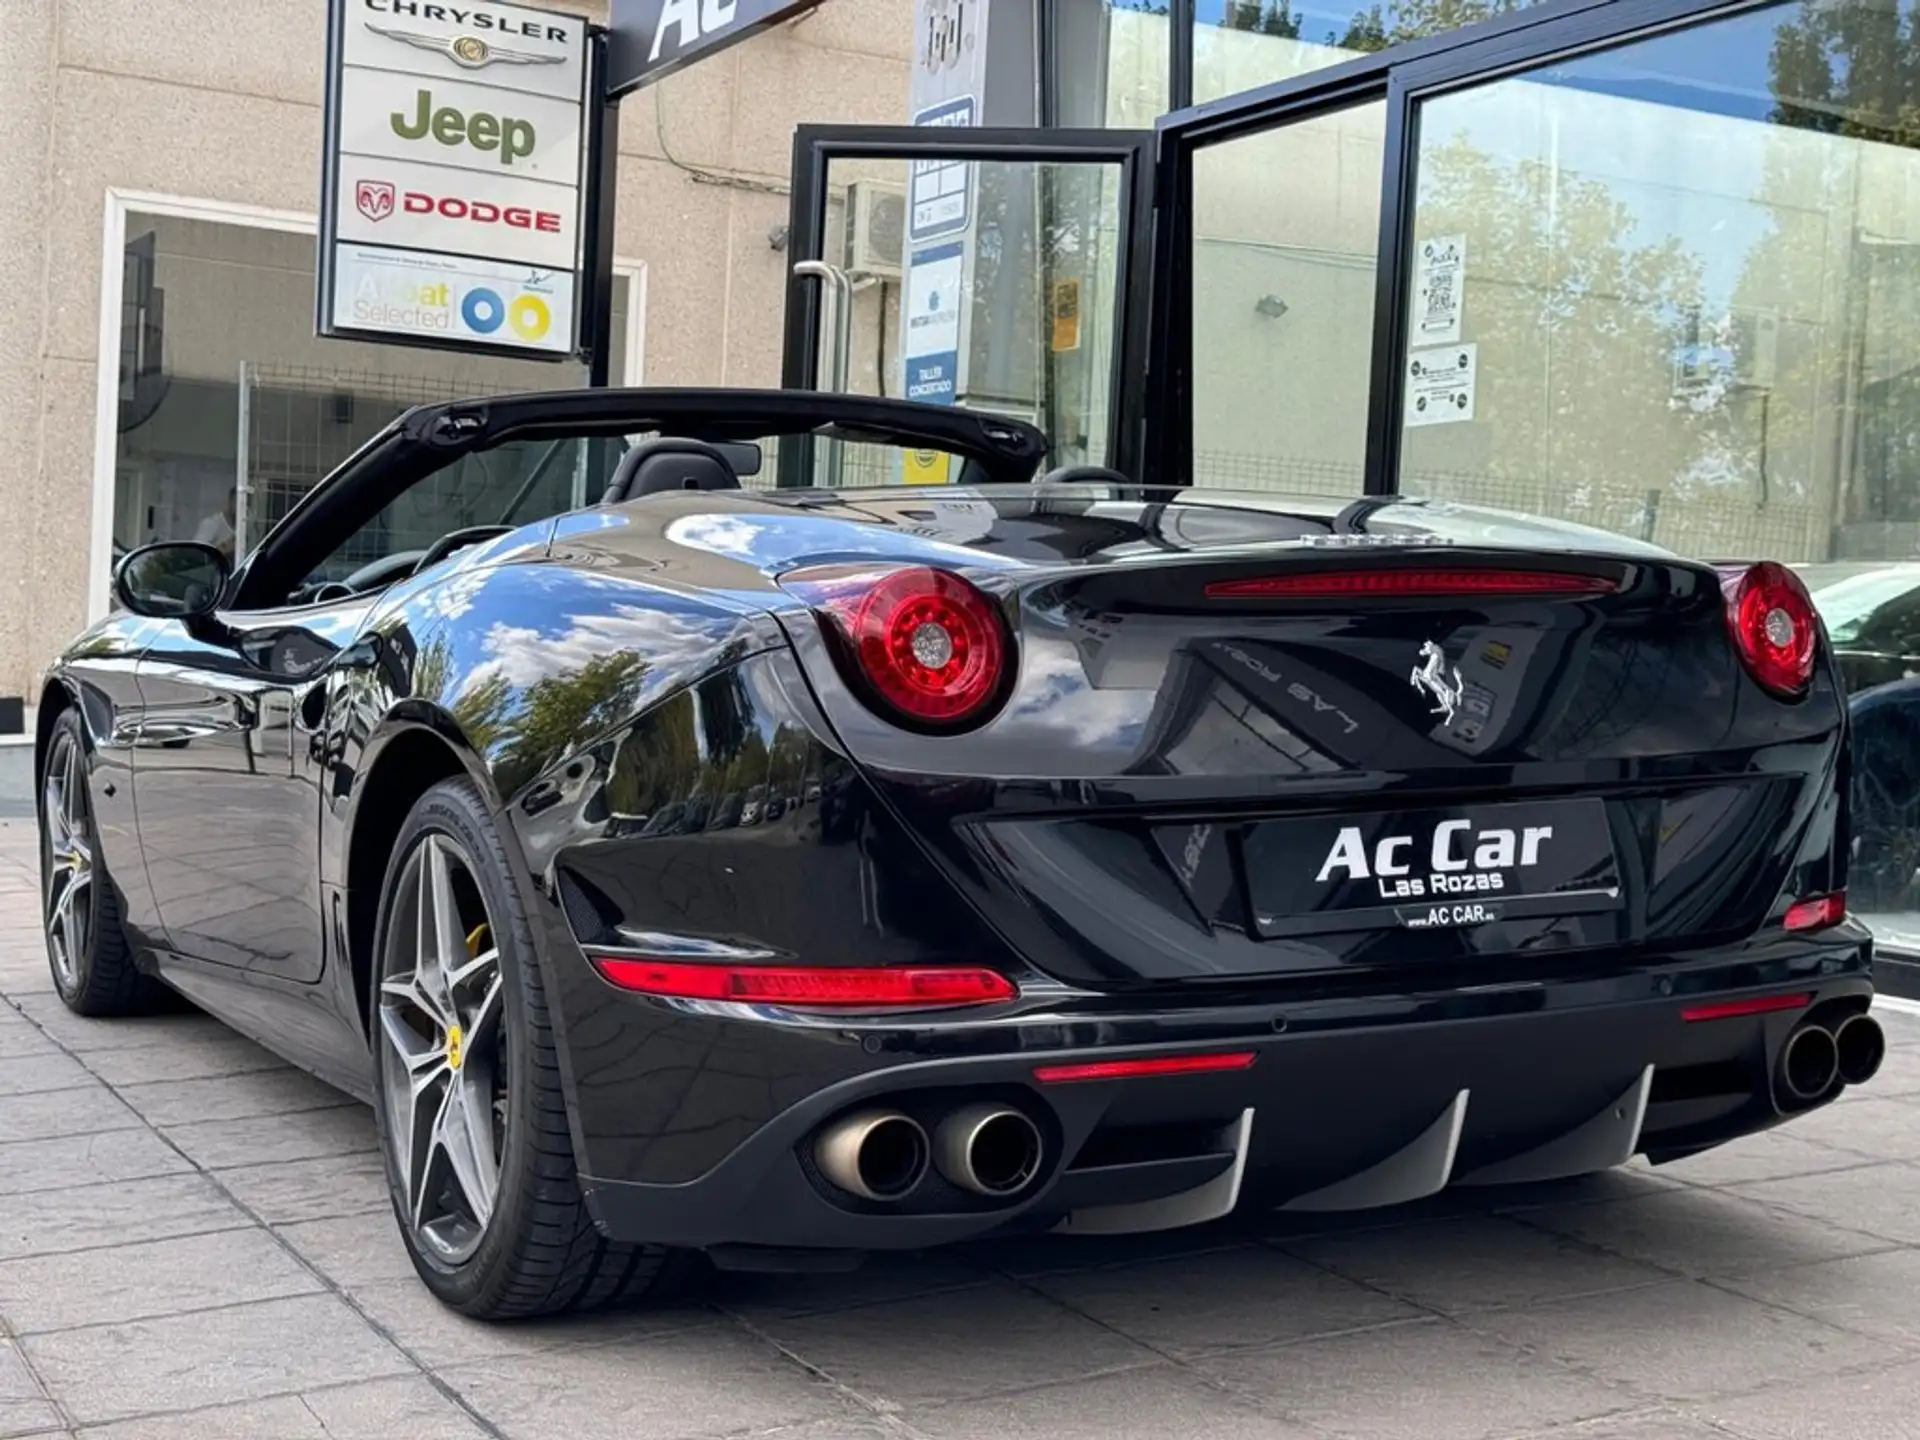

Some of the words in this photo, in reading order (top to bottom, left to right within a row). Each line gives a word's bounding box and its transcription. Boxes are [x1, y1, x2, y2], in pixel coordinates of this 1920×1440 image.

[366, 0, 568, 43] CHRYSLER
[390, 89, 536, 165] Jeep
[403, 191, 561, 233] DODGE
[353, 298, 449, 329] Selected
[1315, 826, 1413, 882] Ac
[1431, 819, 1553, 872] Car
[1379, 877, 1425, 898] Las
[1430, 872, 1505, 894] Rozas
